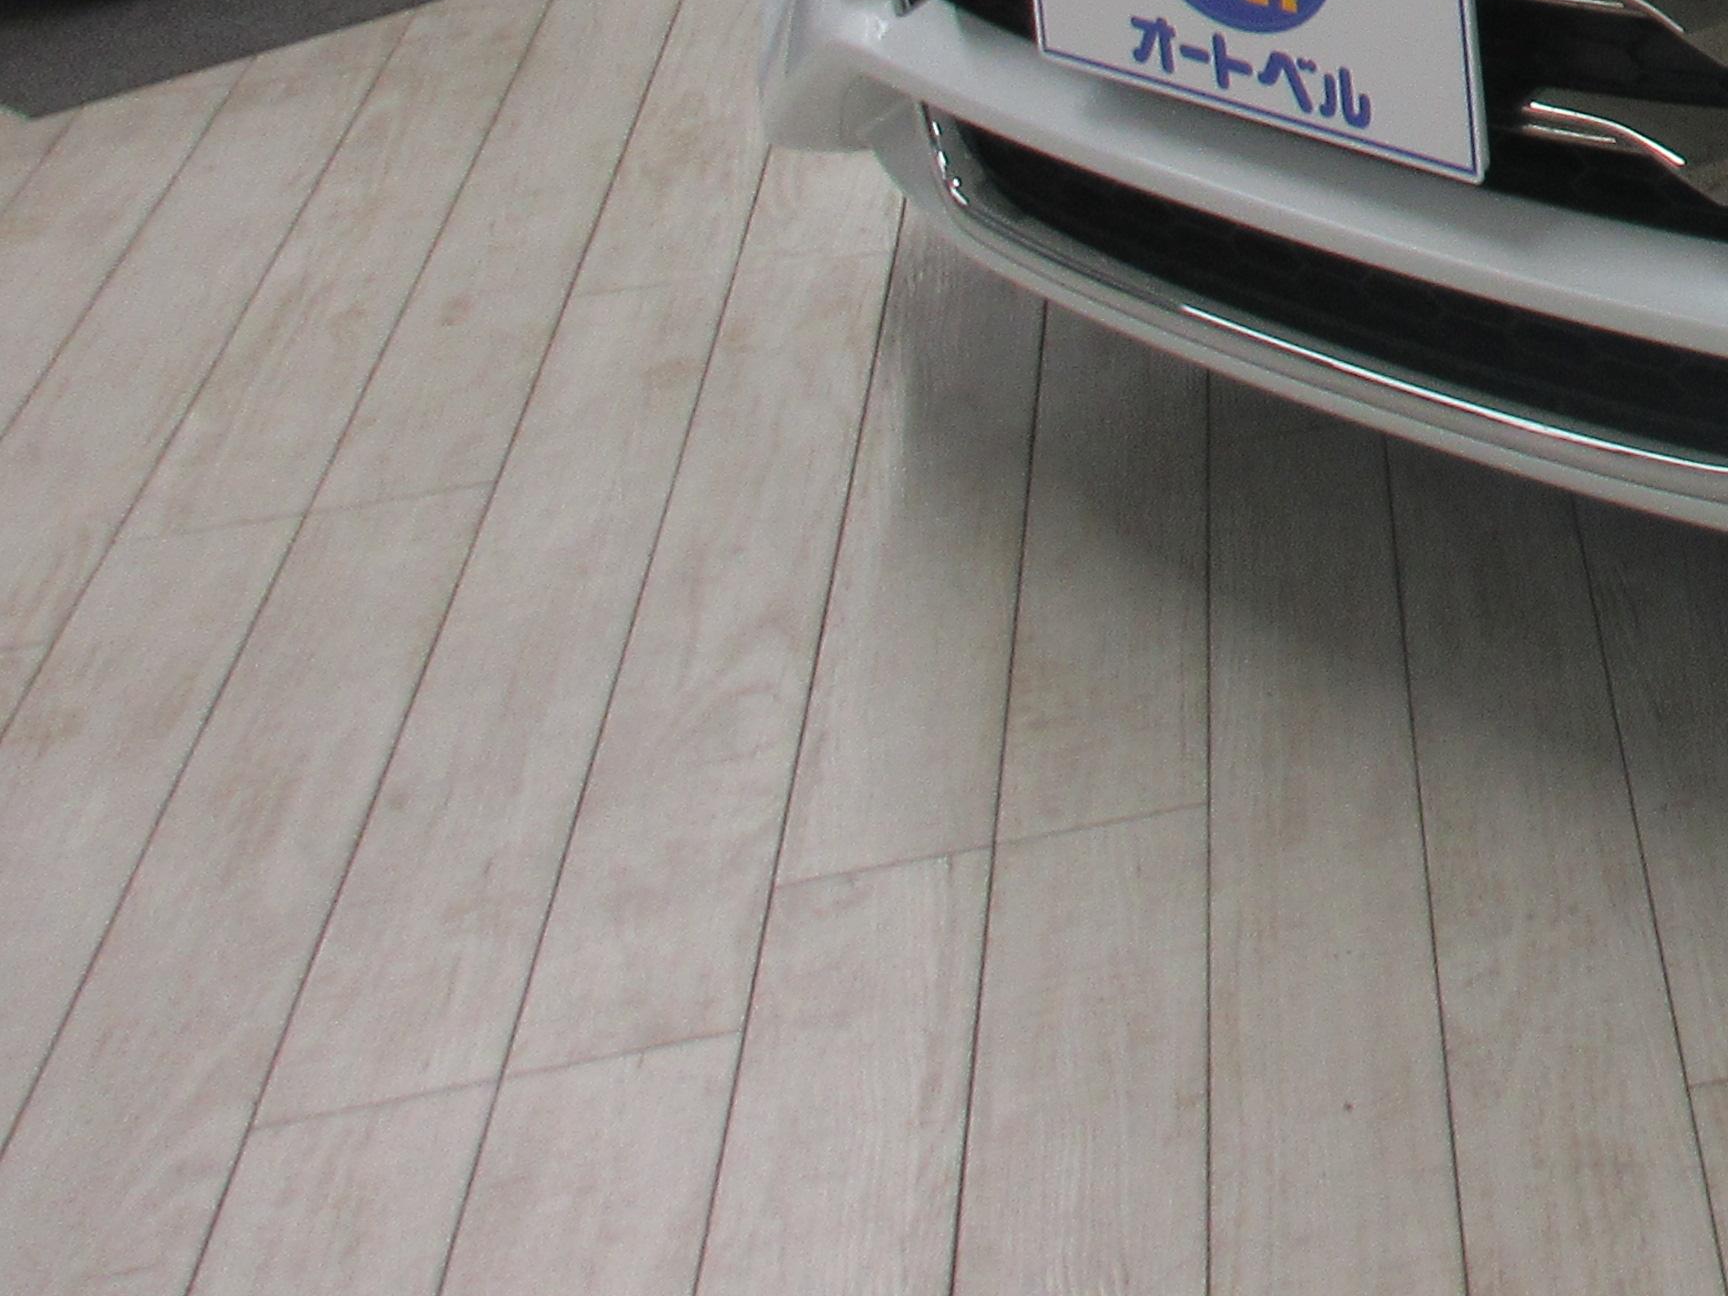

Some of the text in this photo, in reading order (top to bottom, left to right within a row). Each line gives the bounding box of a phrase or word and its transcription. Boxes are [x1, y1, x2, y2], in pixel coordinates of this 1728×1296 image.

[1129, 15, 1372, 129] オートベル
